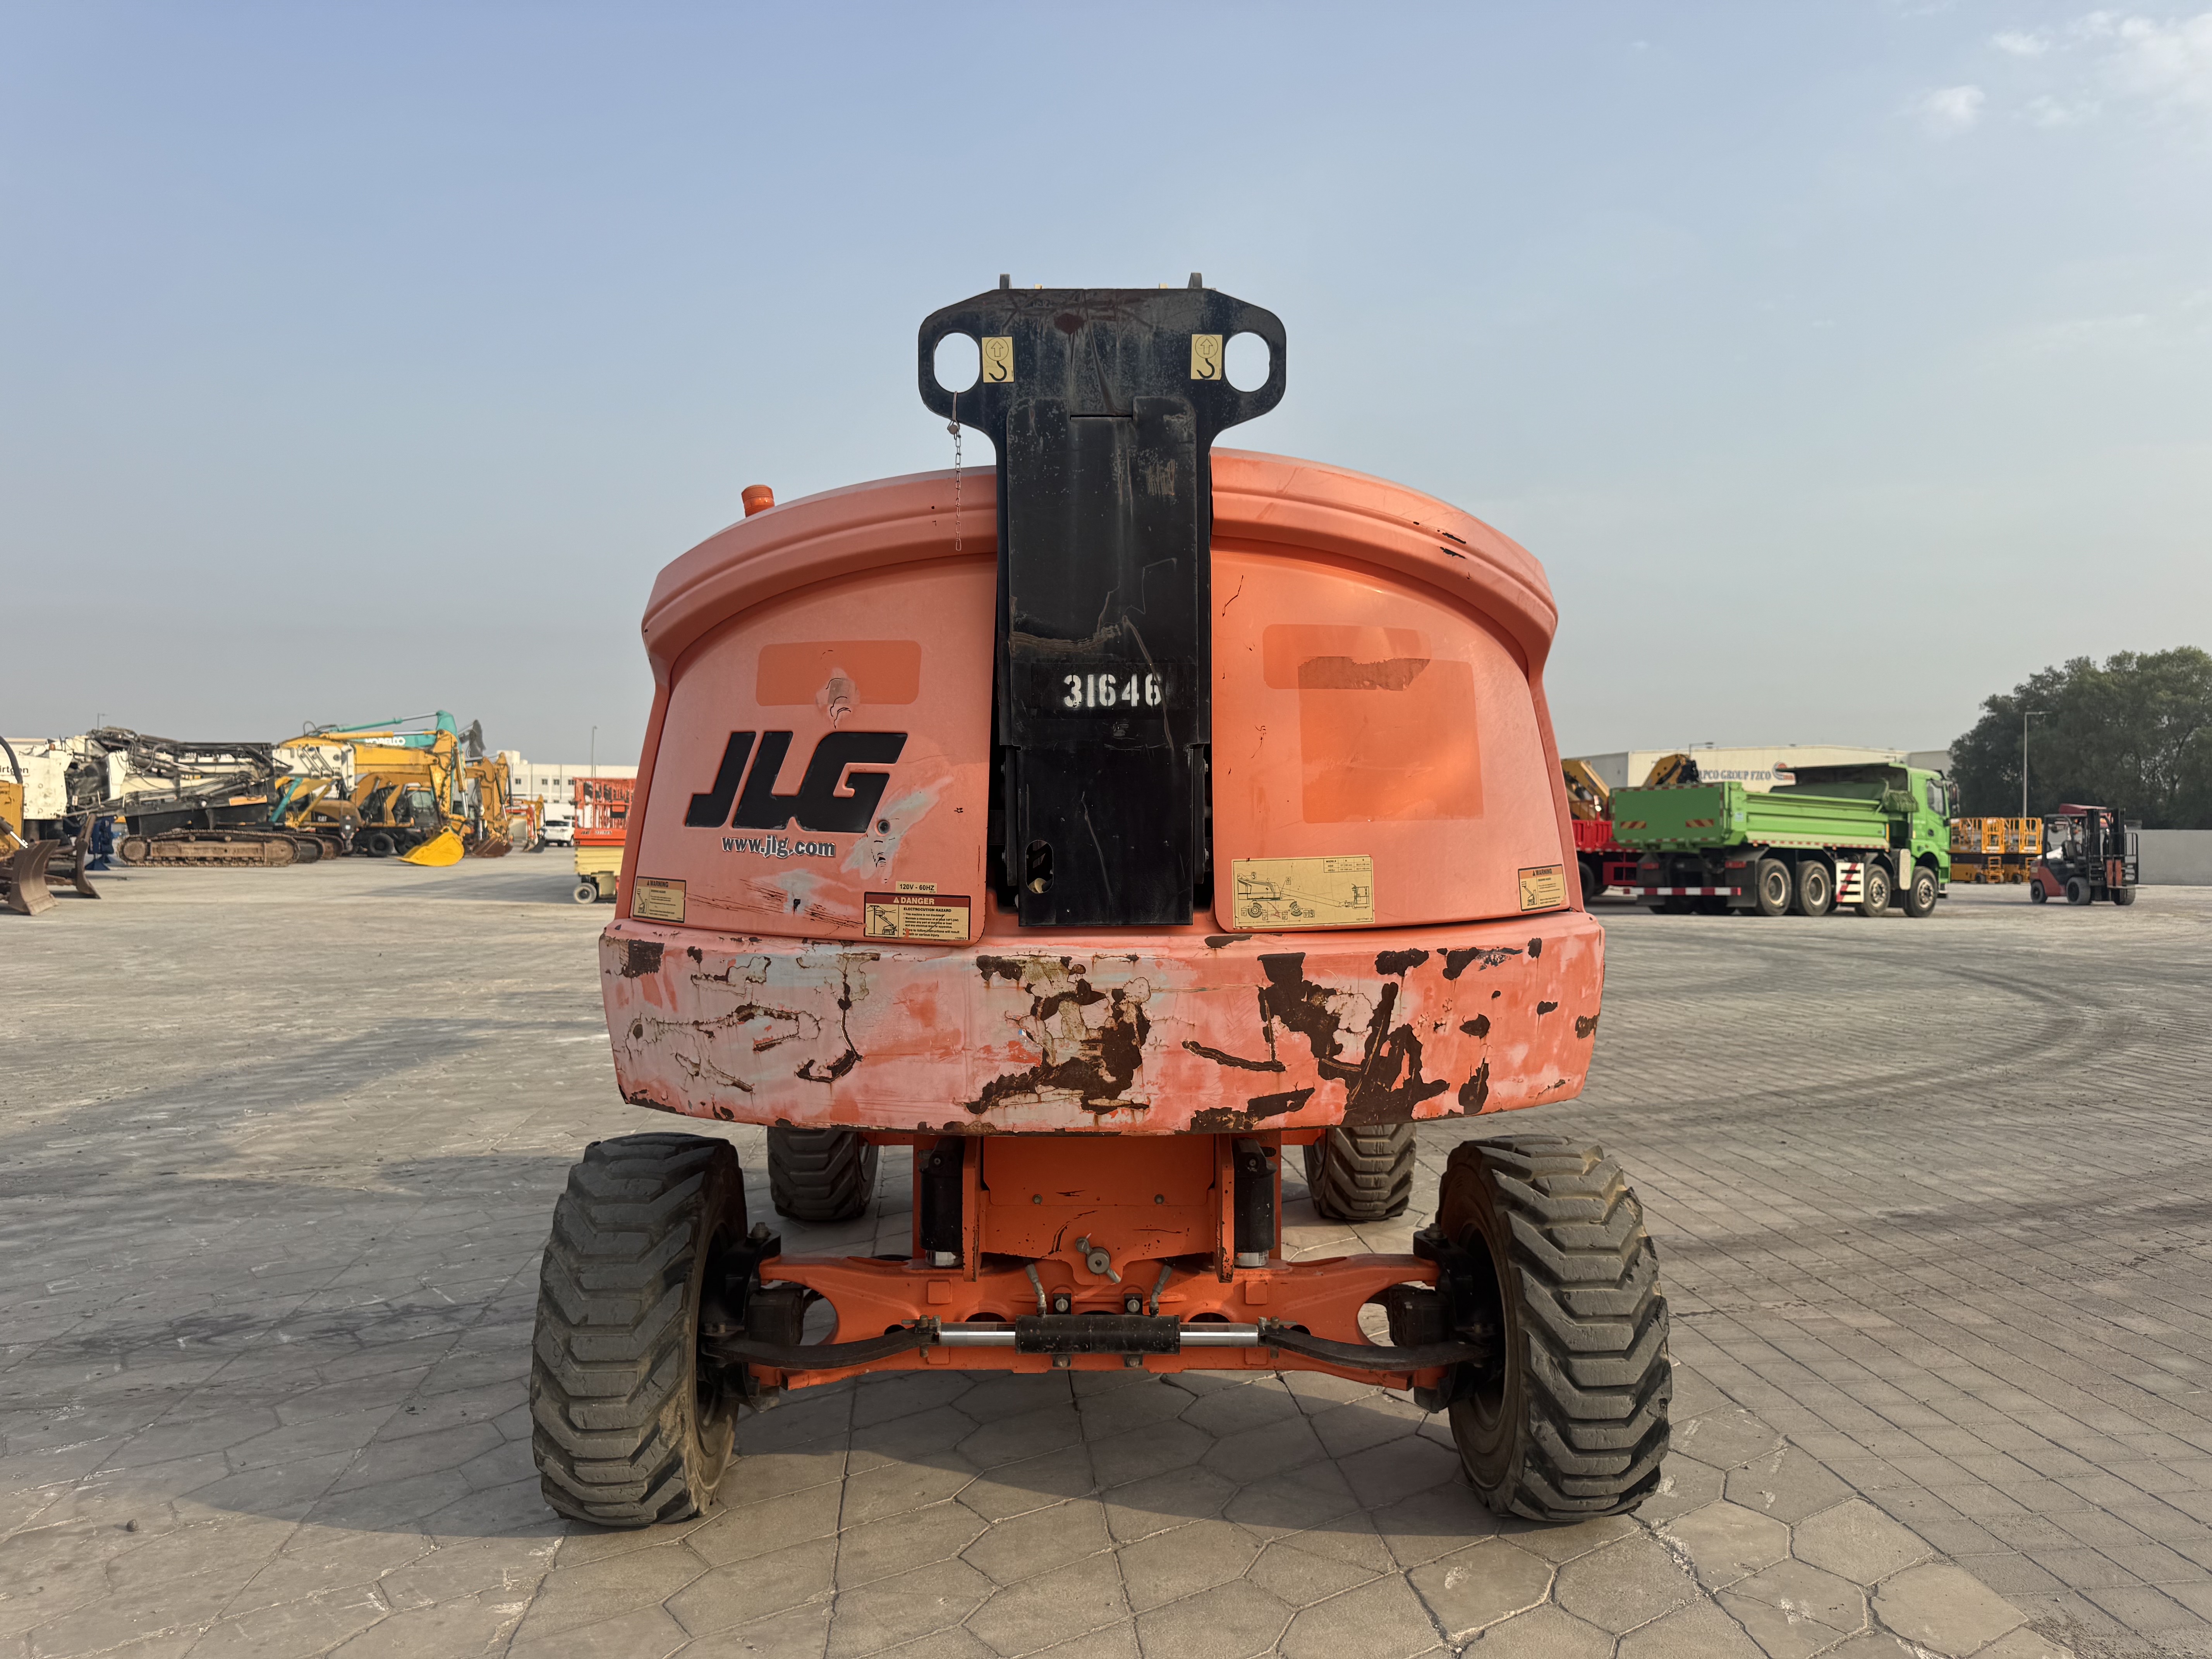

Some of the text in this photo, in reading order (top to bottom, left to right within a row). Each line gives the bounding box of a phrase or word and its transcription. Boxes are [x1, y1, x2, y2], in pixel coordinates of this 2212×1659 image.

[1064, 673, 1161, 708] 31646
[685, 731, 908, 833] JLG
[1721, 770, 1748, 780] GROUP
[722, 835, 835, 858] www.jlg.com
